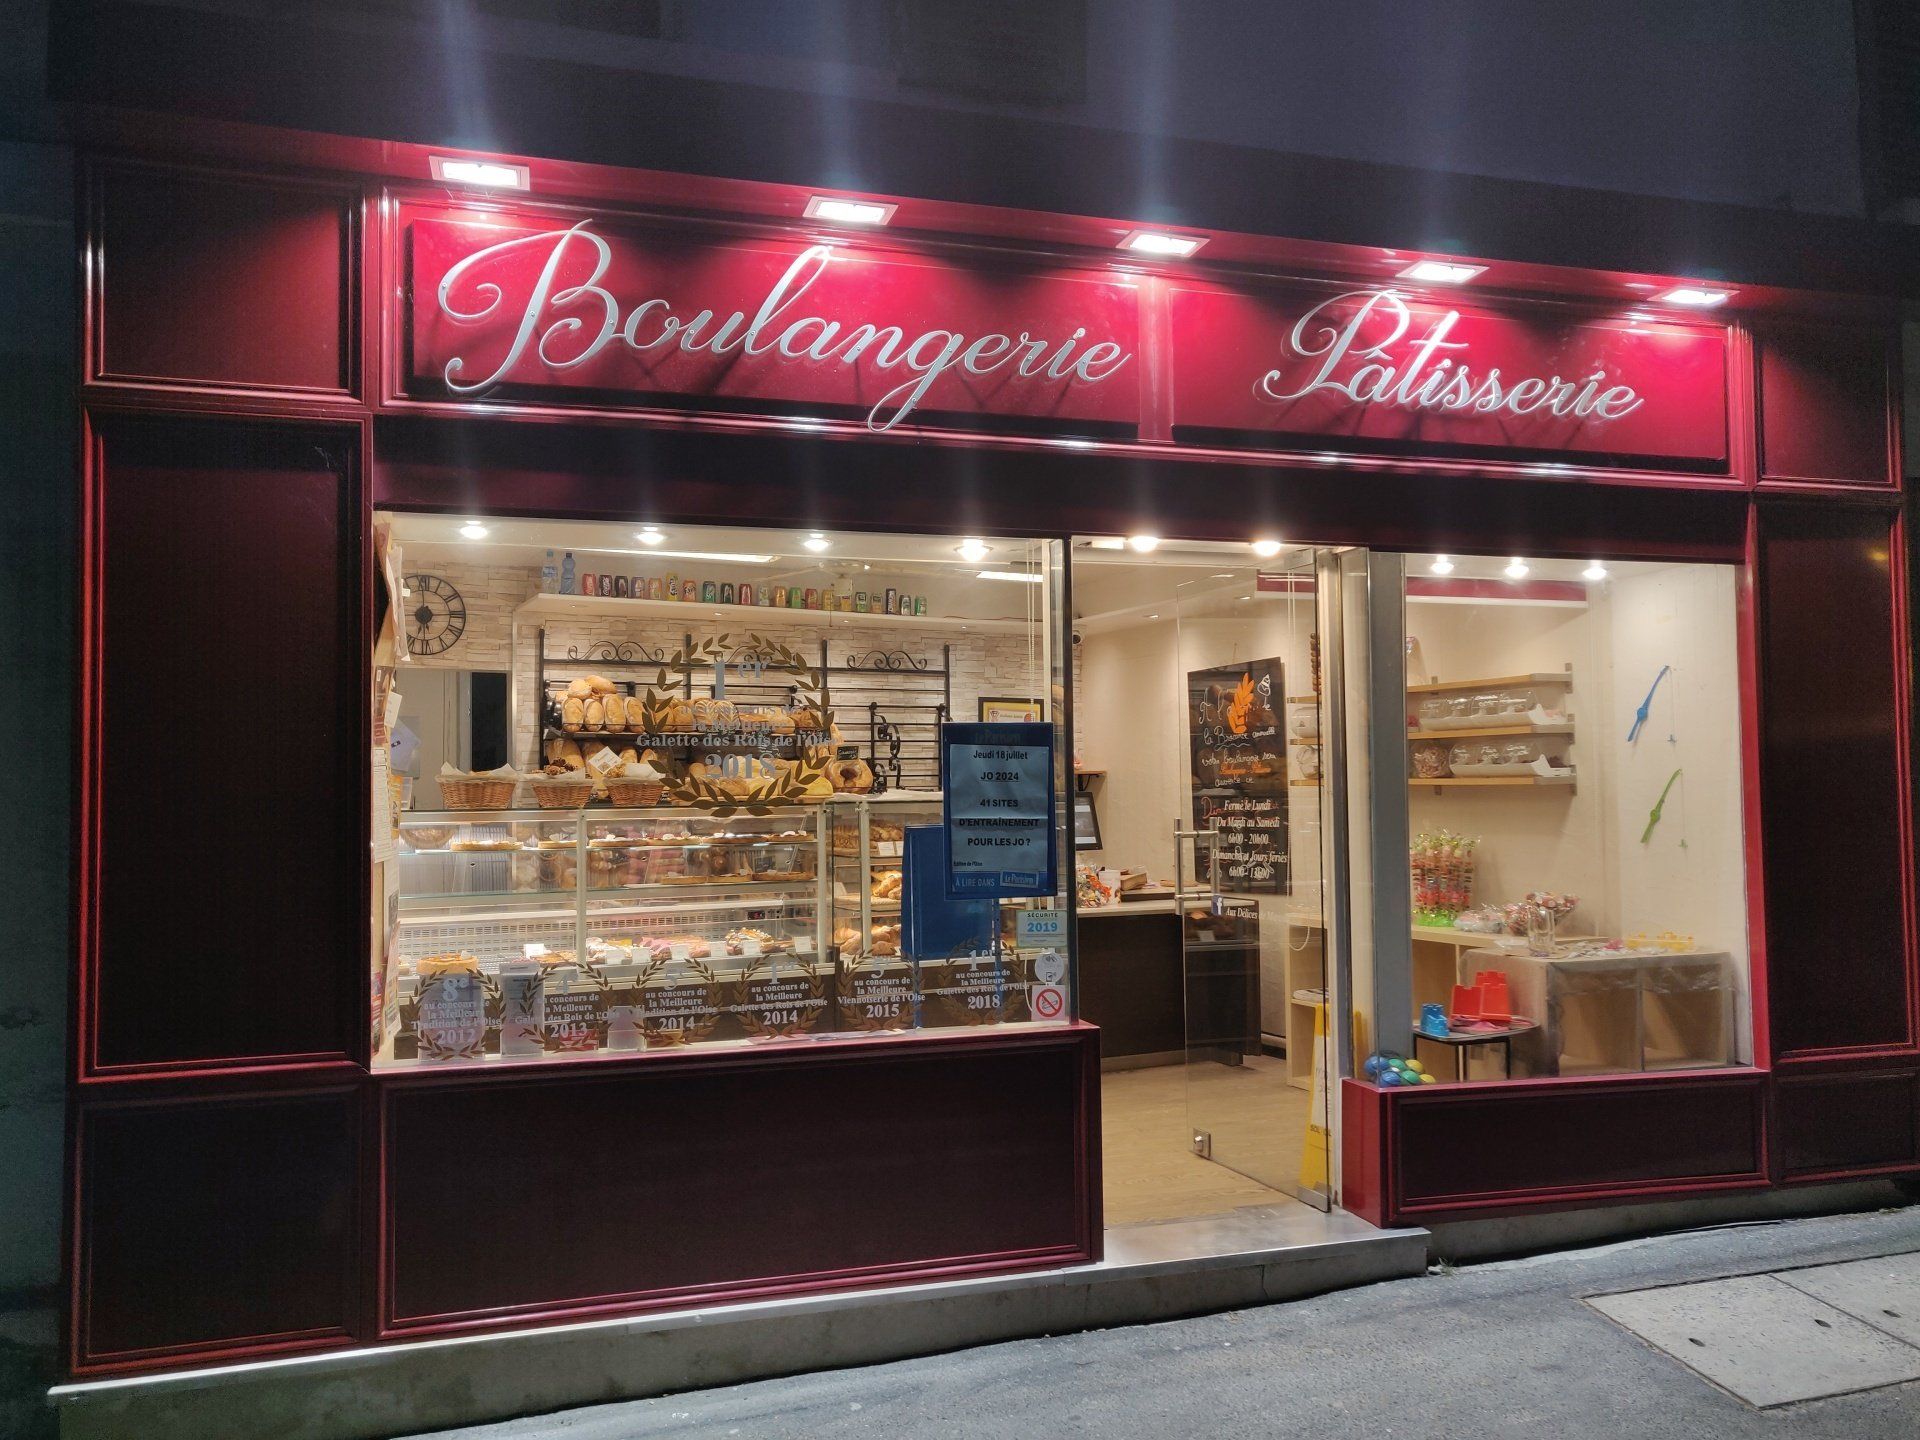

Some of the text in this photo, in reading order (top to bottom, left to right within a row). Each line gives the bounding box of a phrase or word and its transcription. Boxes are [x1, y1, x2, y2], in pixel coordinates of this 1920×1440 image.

[438, 218, 1132, 433] Boulangerie
[1262, 288, 1645, 419] Pâtisserie
[636, 733, 699, 747] Galette
[703, 733, 730, 746] des
[735, 733, 769, 747] Rois
[773, 733, 793, 747] de
[973, 750, 1028, 761] Jeudi 18 juillet
[704, 753, 777, 780] 2018
[981, 772, 1019, 781] JO 2024
[980, 799, 1018, 807] 41 SITES
[1224, 800, 1244, 811] Fermé
[1245, 799, 1251, 810] le
[1252, 799, 1271, 810] Lundi
[1216, 817, 1226, 827] Du
[1256, 816, 1280, 827] Samedi
[967, 838, 993, 846] POUR
[994, 838, 1012, 846] LES
[1012, 838, 1024, 846] JO
[1228, 833, 1244, 844] 6h00
[1249, 833, 1269, 844] 20h00
[1250, 851, 1268, 862] Jours
[1226, 907, 1236, 916] Aux
[1237, 908, 1258, 919] Délices
[1027, 921, 1058, 932] 2019
[966, 970, 1000, 979] concours
[1001, 968, 1010, 977] de
[866, 978, 900, 986] concours
[901, 976, 911, 984] de
[969, 977, 1006, 986] Meilleure
[763, 984, 798, 992] concours
[800, 982, 809, 990] de
[857, 986, 907, 995] la Meilleure
[966, 986, 979, 994] des
[550, 995, 587, 1003] concours
[589, 993, 599, 1001] de
[645, 988, 707, 999] au concours de
[756, 992, 802, 1002] la Meilleure
[837, 992, 926, 1005] Viennoiserie de l'Oise
[649, 998, 703, 1008] la Meilleure
[967, 994, 1001, 1010] 2018
[553, 1004, 593, 1012] Meilleure
[865, 1003, 900, 1018] 2015
[548, 1014, 561, 1022] des
[563, 1013, 583, 1021] Rois
[585, 1012, 595, 1020] de
[763, 1009, 798, 1025] 2014
[658, 1016, 696, 1030] 2014
[550, 1022, 588, 1038] 2013
